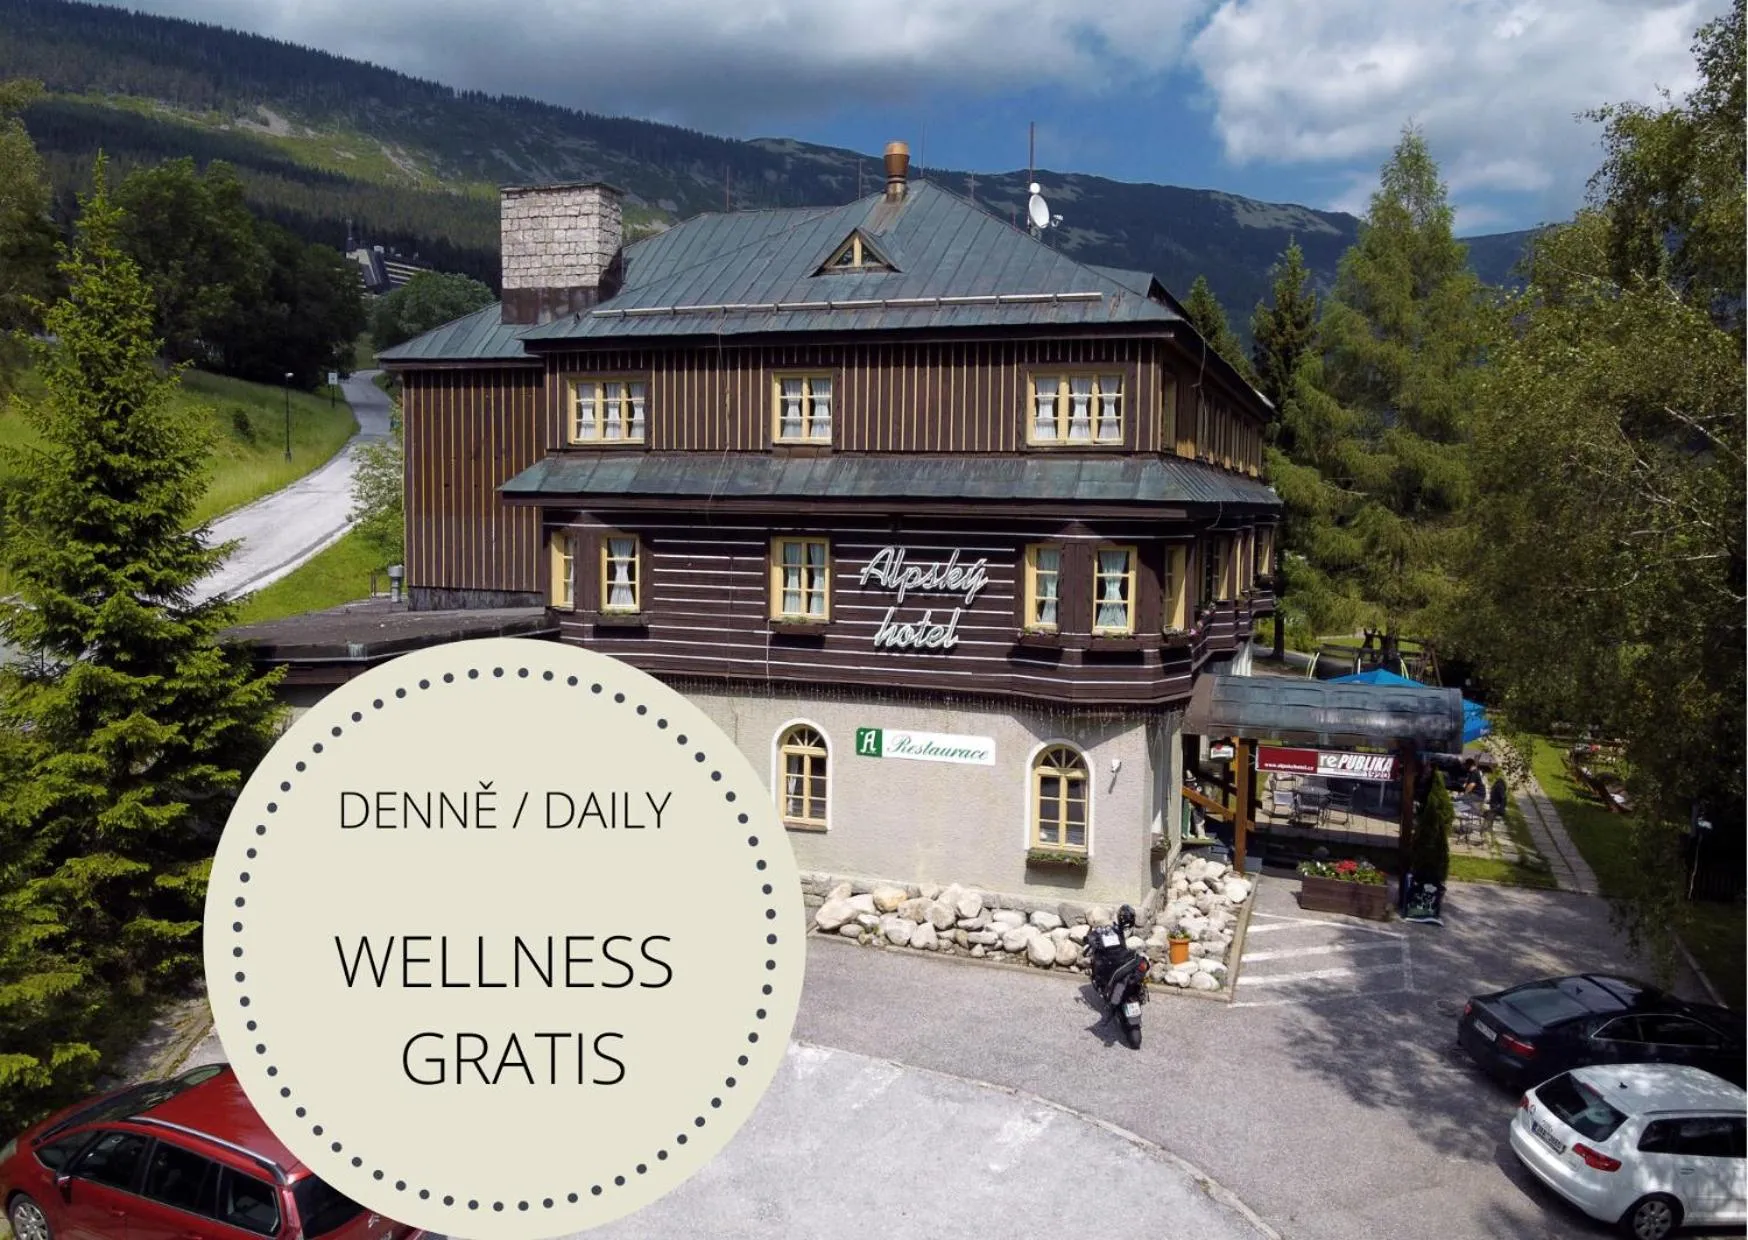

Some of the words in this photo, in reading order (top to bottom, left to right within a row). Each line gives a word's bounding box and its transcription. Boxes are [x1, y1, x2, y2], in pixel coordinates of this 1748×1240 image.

[860, 546, 988, 604] Alpský
[873, 606, 960, 648] hotel
[886, 734, 989, 761] Restaurace
